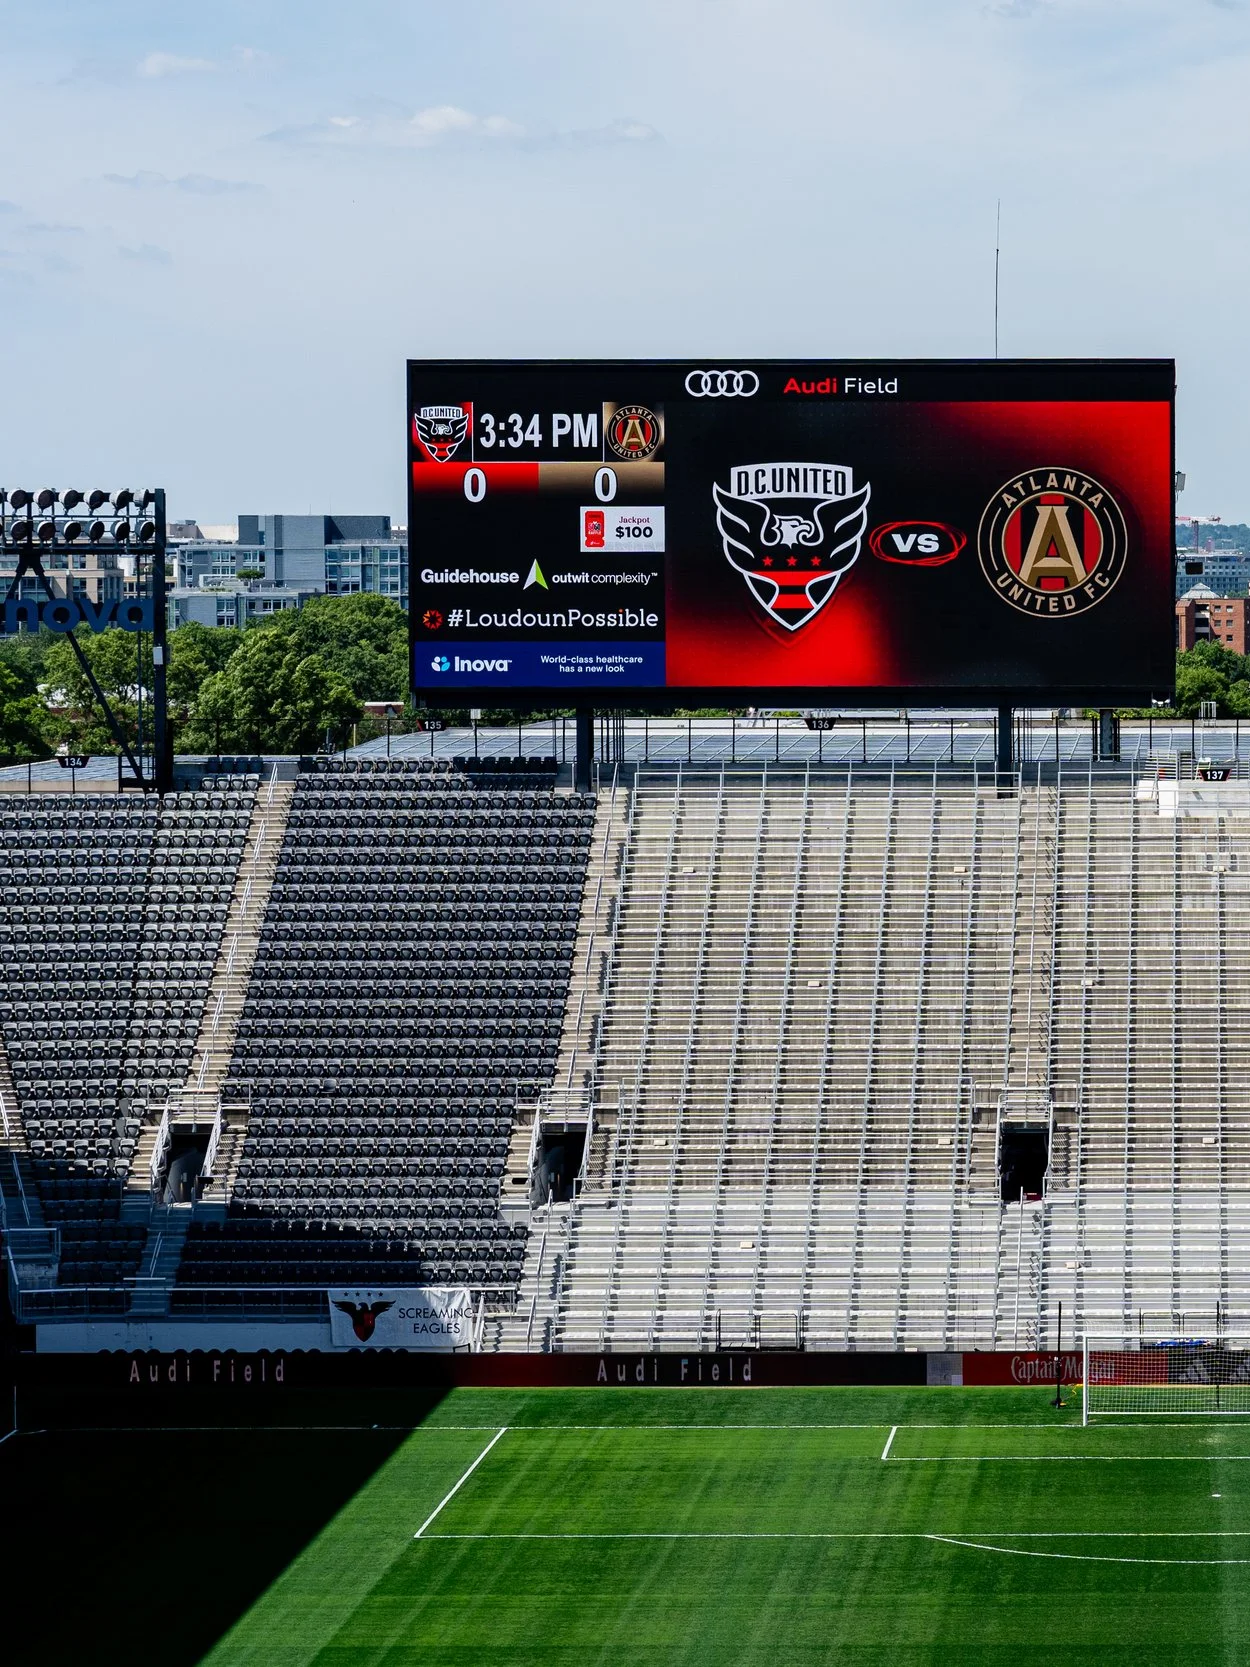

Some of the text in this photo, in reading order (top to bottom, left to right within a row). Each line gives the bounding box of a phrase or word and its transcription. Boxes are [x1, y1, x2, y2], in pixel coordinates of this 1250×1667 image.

[784, 378, 898, 394] Audi Field
[615, 407, 653, 421] ATLANTA
[480, 413, 598, 448] 3:34 PM
[613, 443, 655, 458] UNITED FC
[464, 467, 487, 502] 0
[594, 467, 617, 502] 0
[1002, 473, 1104, 509] ATLANTA
[619, 516, 650, 525] Jackpot
[615, 526, 653, 539] $100
[892, 533, 940, 553] VS
[420, 568, 519, 584] Guidehouse
[552, 572, 590, 584] outwit
[997, 572, 1110, 612] UNITED FC
[447, 608, 659, 627] #LoudounPossible
[541, 655, 643, 664] World-class healthcare
[559, 664, 575, 673] has
[605, 664, 625, 673] look
[424, 720, 442, 730] 135
[812, 720, 830, 729] 136
[64, 757, 82, 766] 134
[1206, 770, 1224, 780] 137
[413, 1322, 461, 1334] EAGLES
[129, 1359, 284, 1382] Audi Field
[597, 1358, 752, 1382] Audi Field
